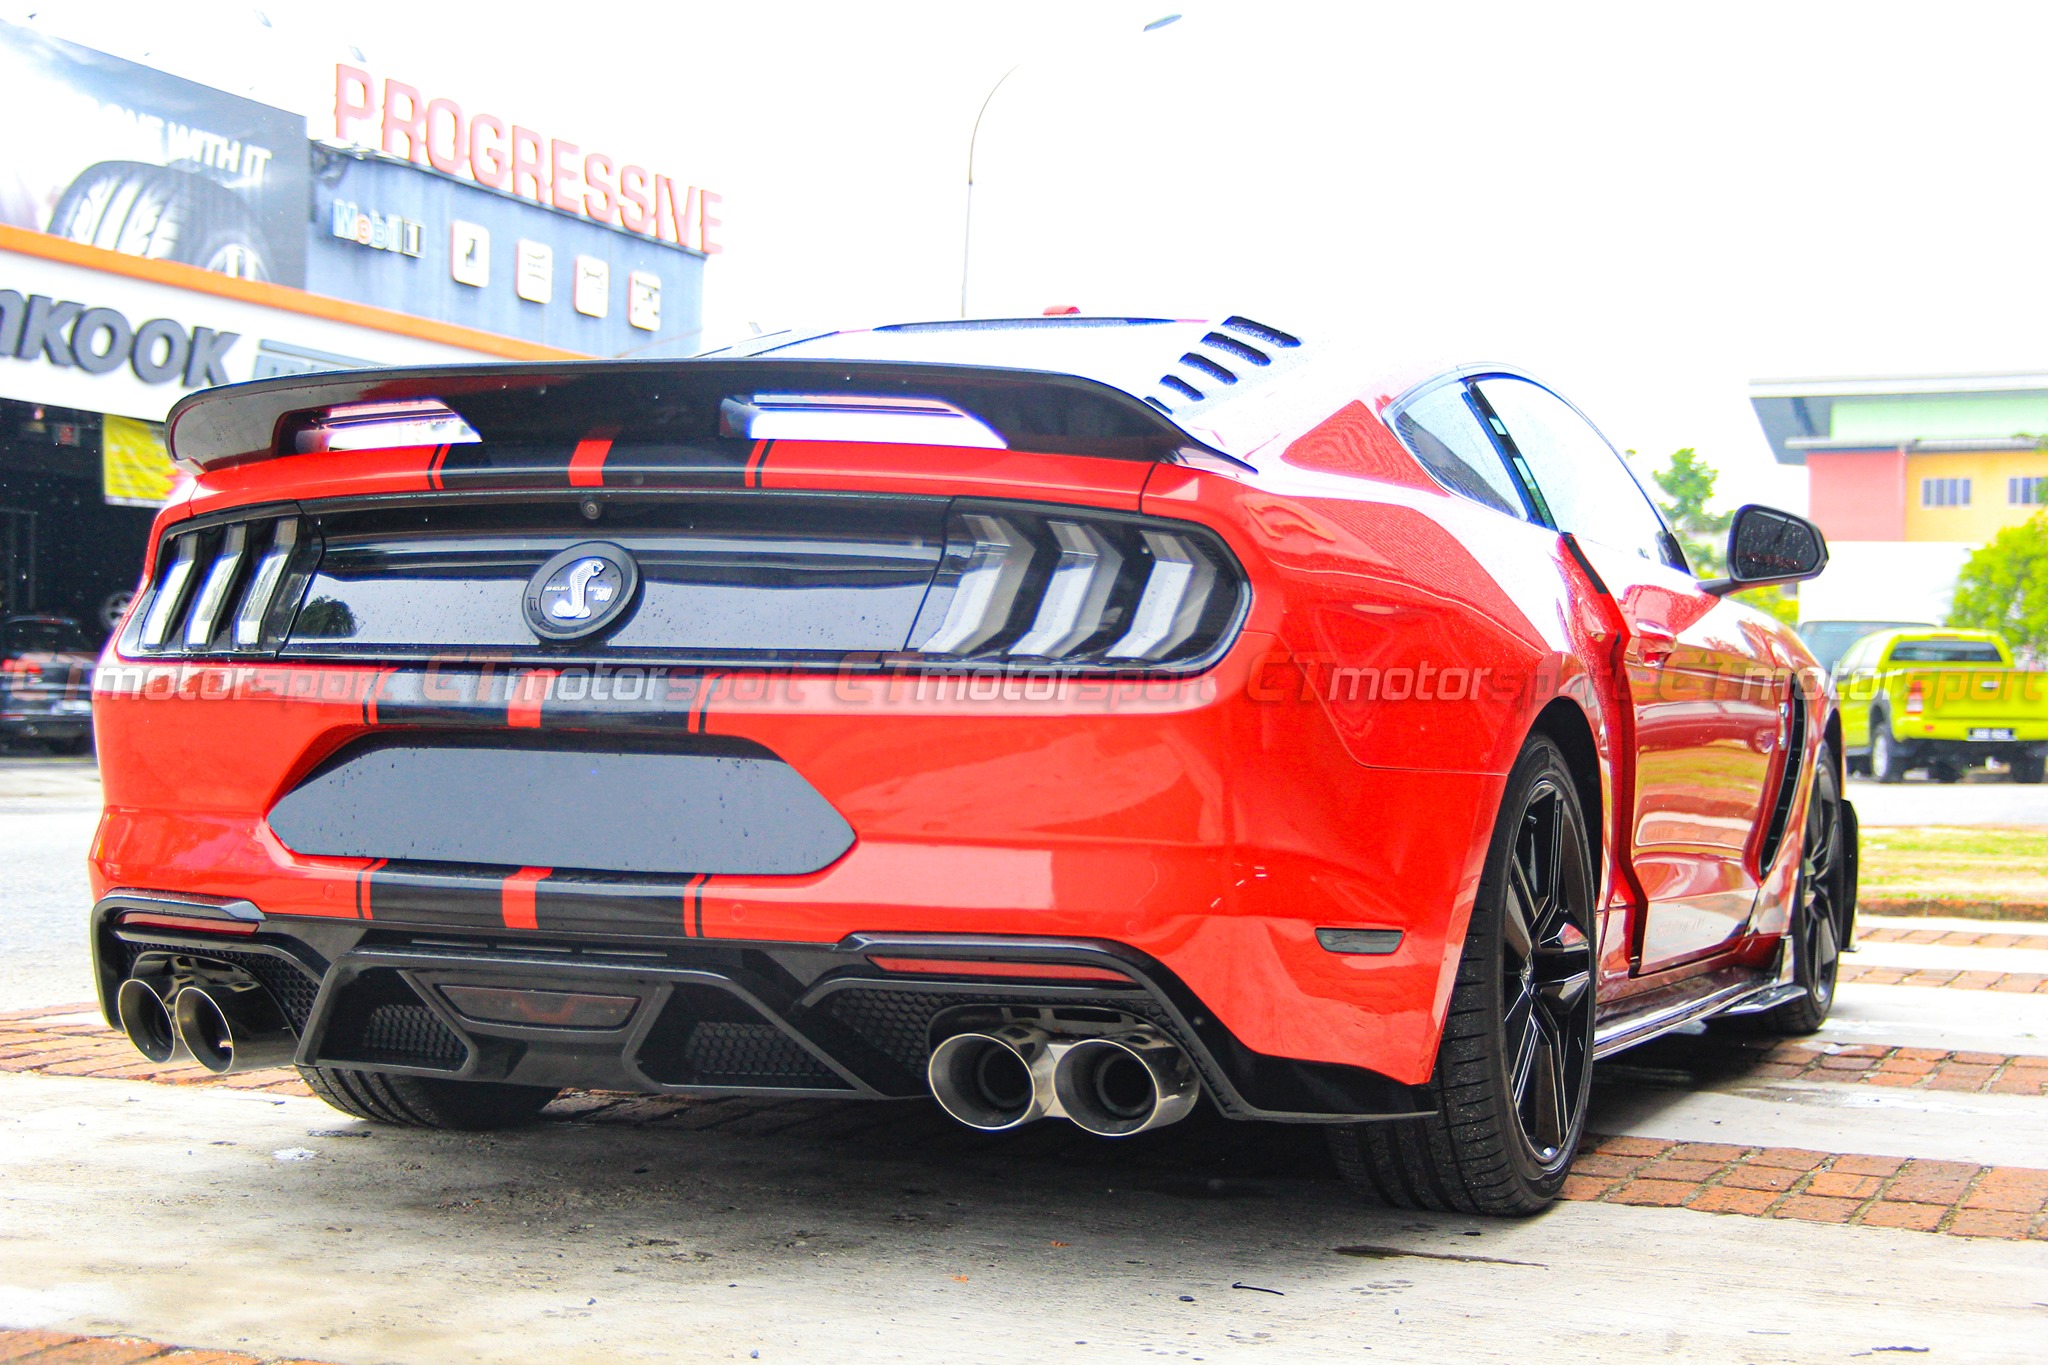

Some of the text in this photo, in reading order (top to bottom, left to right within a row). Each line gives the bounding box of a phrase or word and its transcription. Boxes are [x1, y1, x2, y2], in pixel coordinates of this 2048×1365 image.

[167, 121, 242, 174] WITH
[242, 144, 273, 182] IT
[334, 63, 723, 254] PROGRESSIVE
